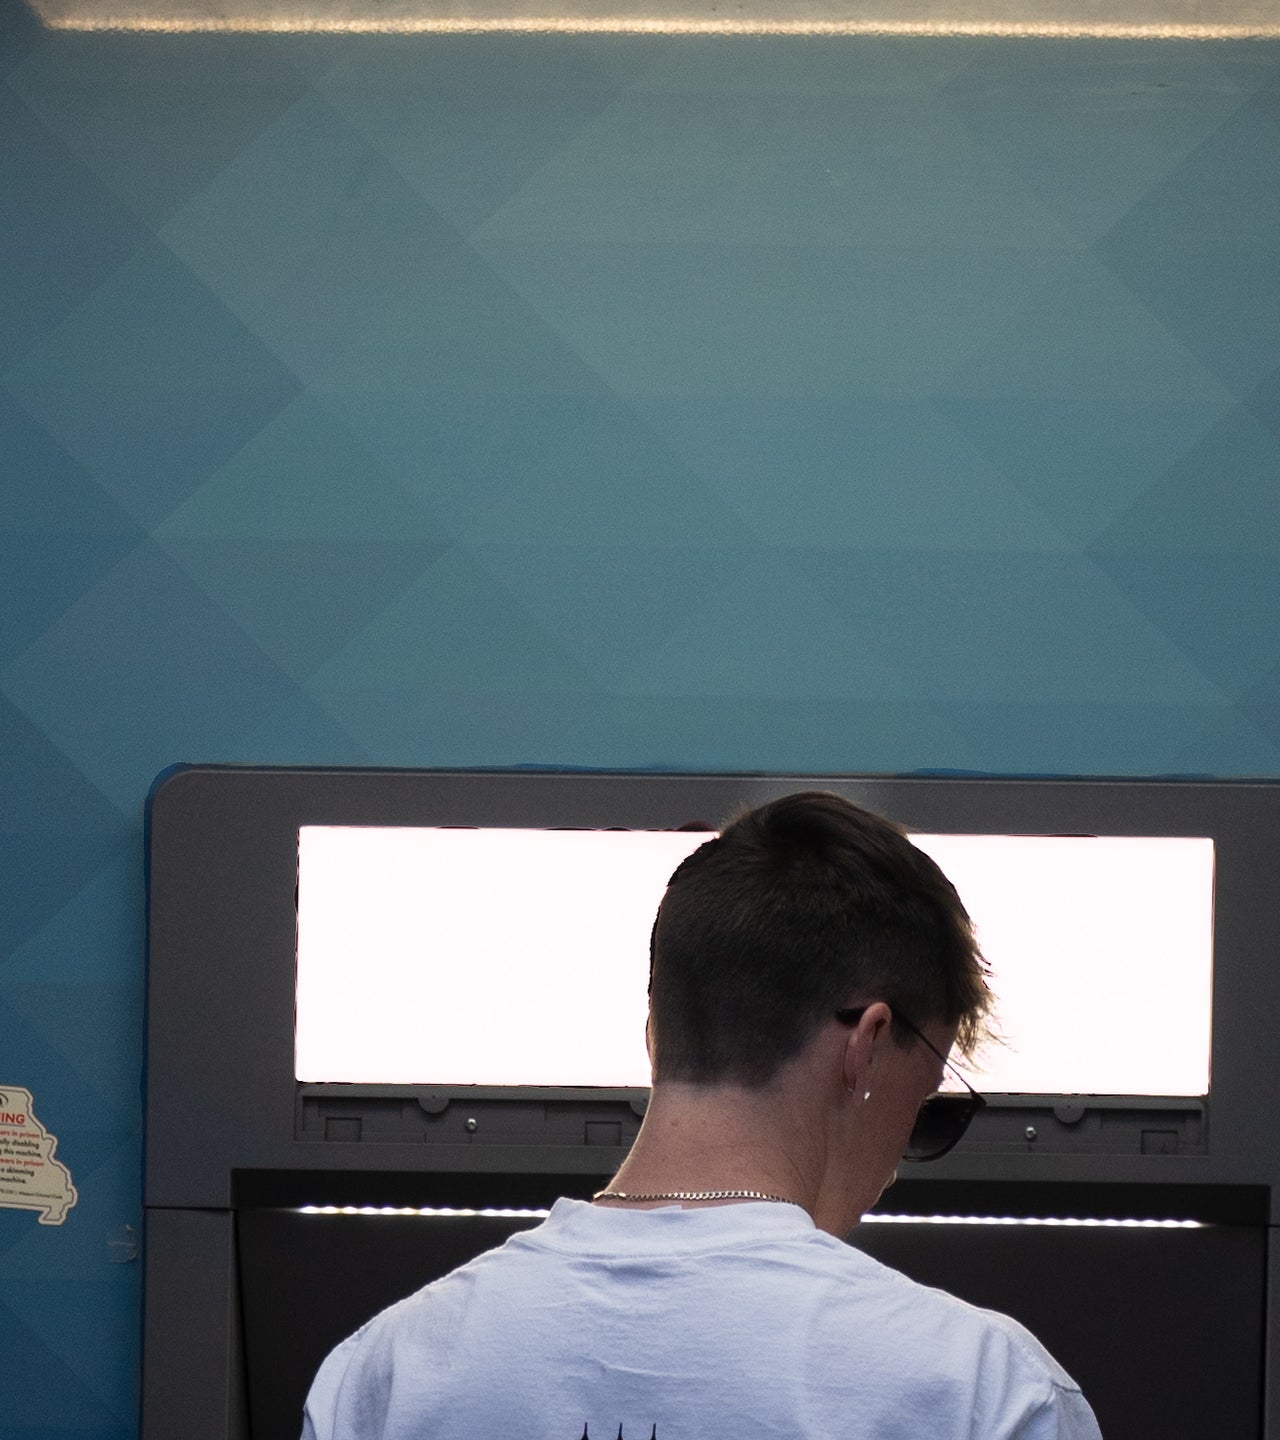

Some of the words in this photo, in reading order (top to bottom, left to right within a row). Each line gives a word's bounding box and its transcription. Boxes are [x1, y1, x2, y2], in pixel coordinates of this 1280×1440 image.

[19, 1131, 40, 1139] prison
[23, 1159, 44, 1167] prison
[7, 1167, 35, 1177] skimming
